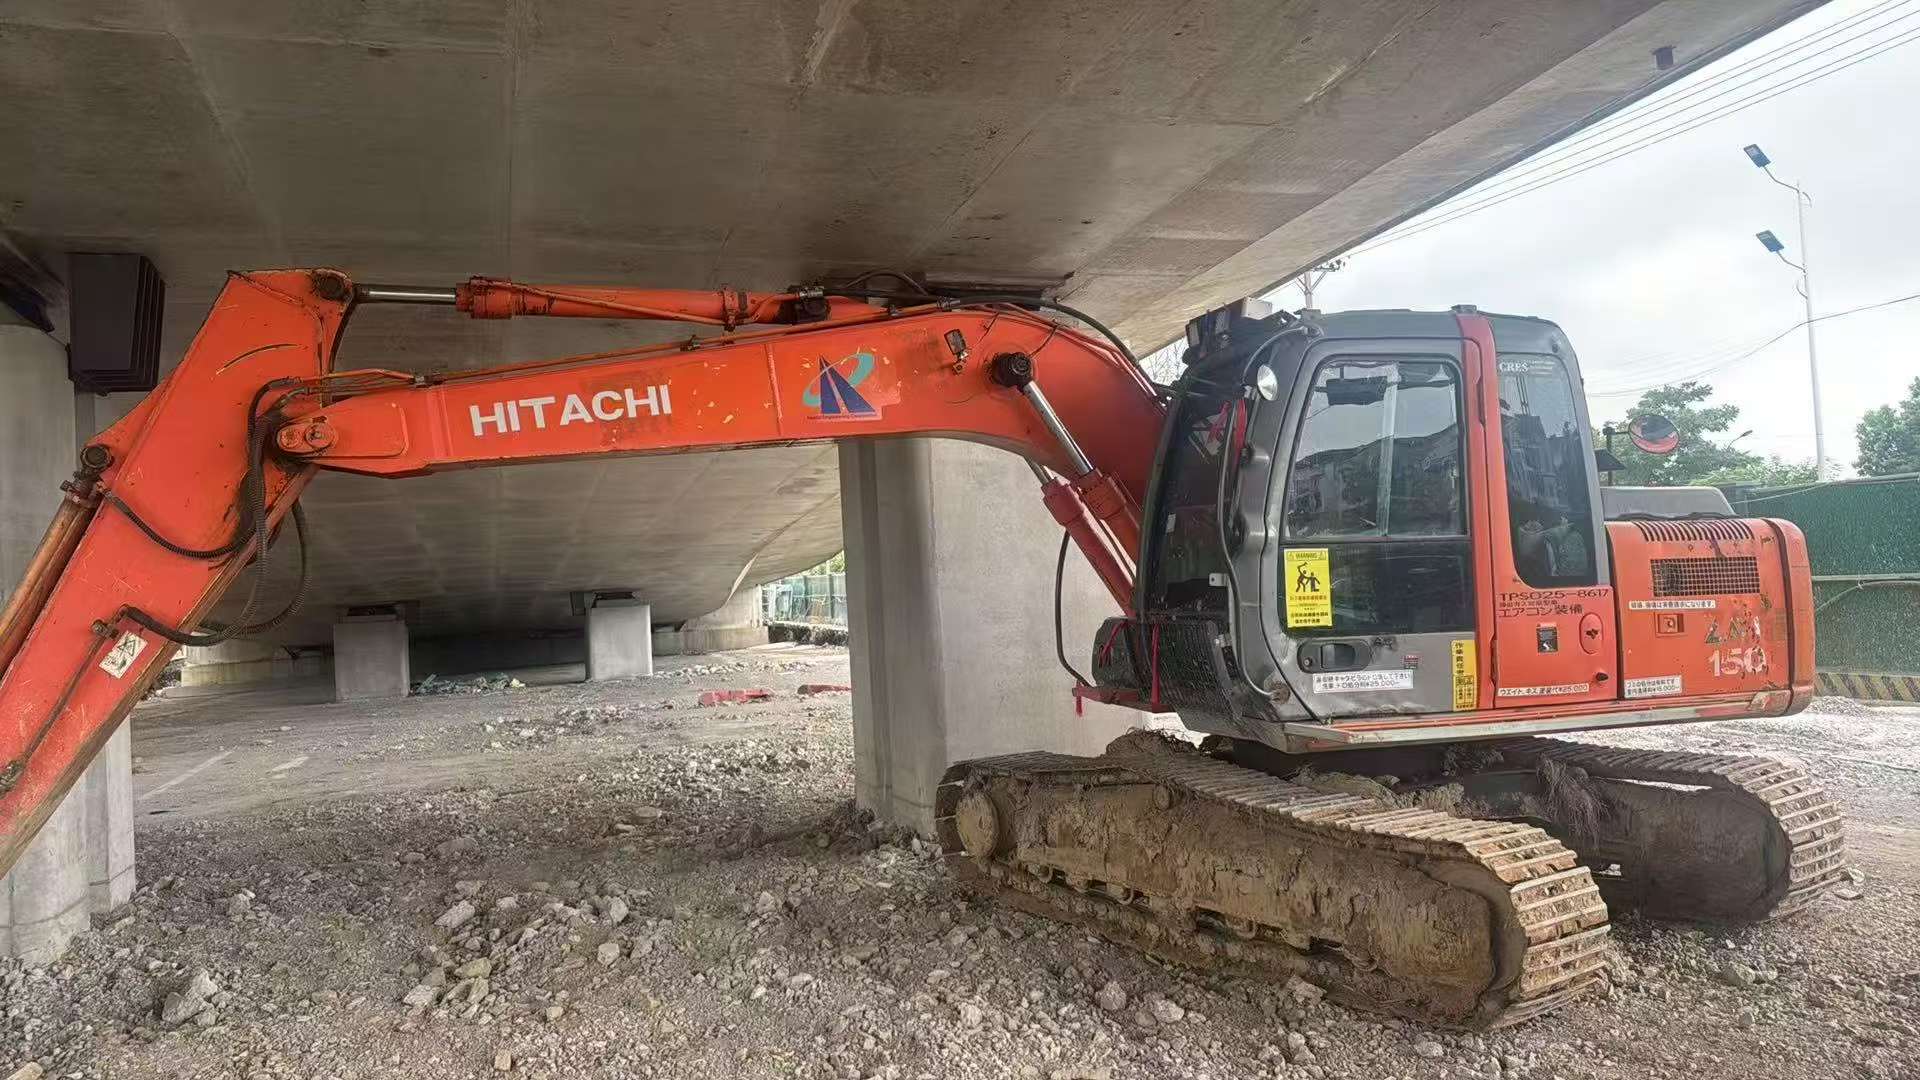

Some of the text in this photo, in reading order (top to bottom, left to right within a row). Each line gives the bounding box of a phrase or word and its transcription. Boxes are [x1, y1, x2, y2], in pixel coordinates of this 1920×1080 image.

[469, 384, 673, 436] HITACHI
[1499, 604, 1583, 617] エアコン装備
[1709, 648, 1766, 676] 150
